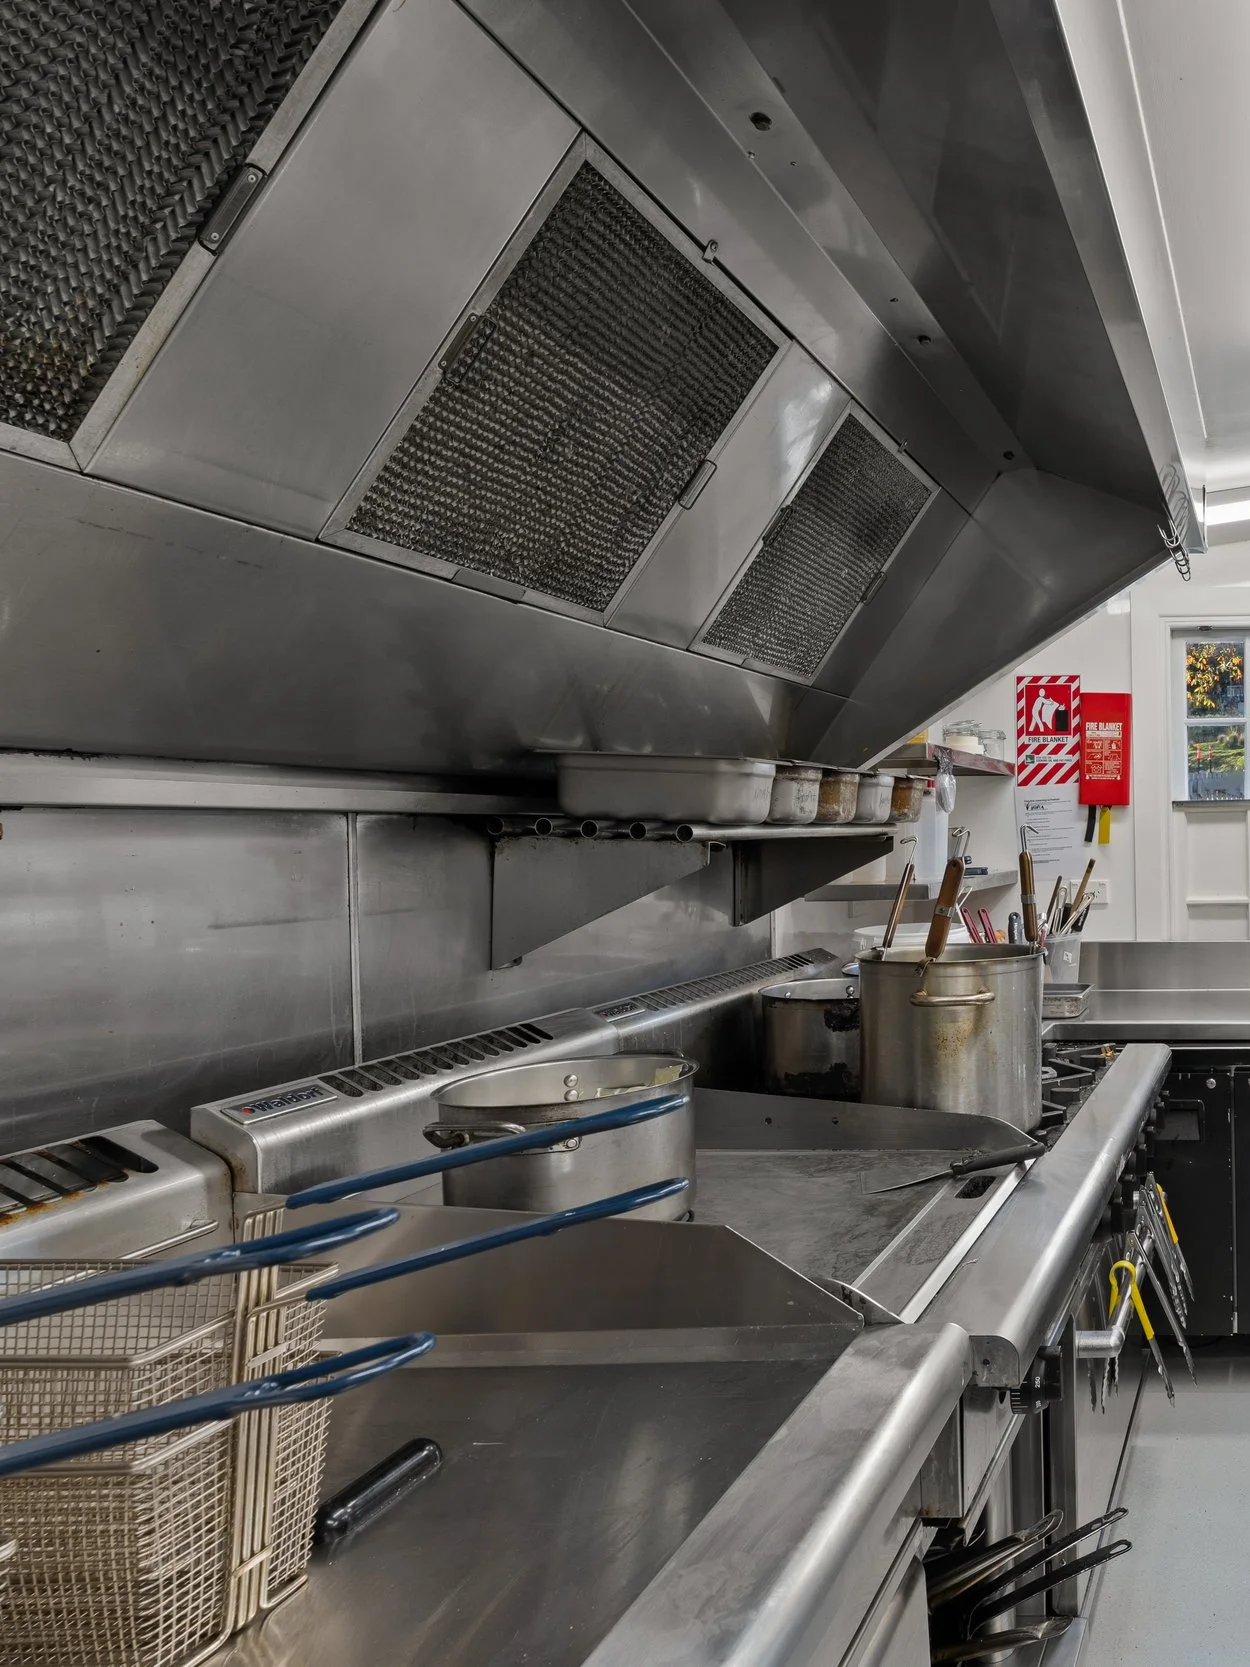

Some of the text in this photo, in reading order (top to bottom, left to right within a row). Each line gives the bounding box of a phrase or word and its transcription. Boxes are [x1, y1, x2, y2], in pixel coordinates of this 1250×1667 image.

[1086, 722, 1122, 731] FIRE BLANKET
[250, 1086, 324, 1112] Waldorf
